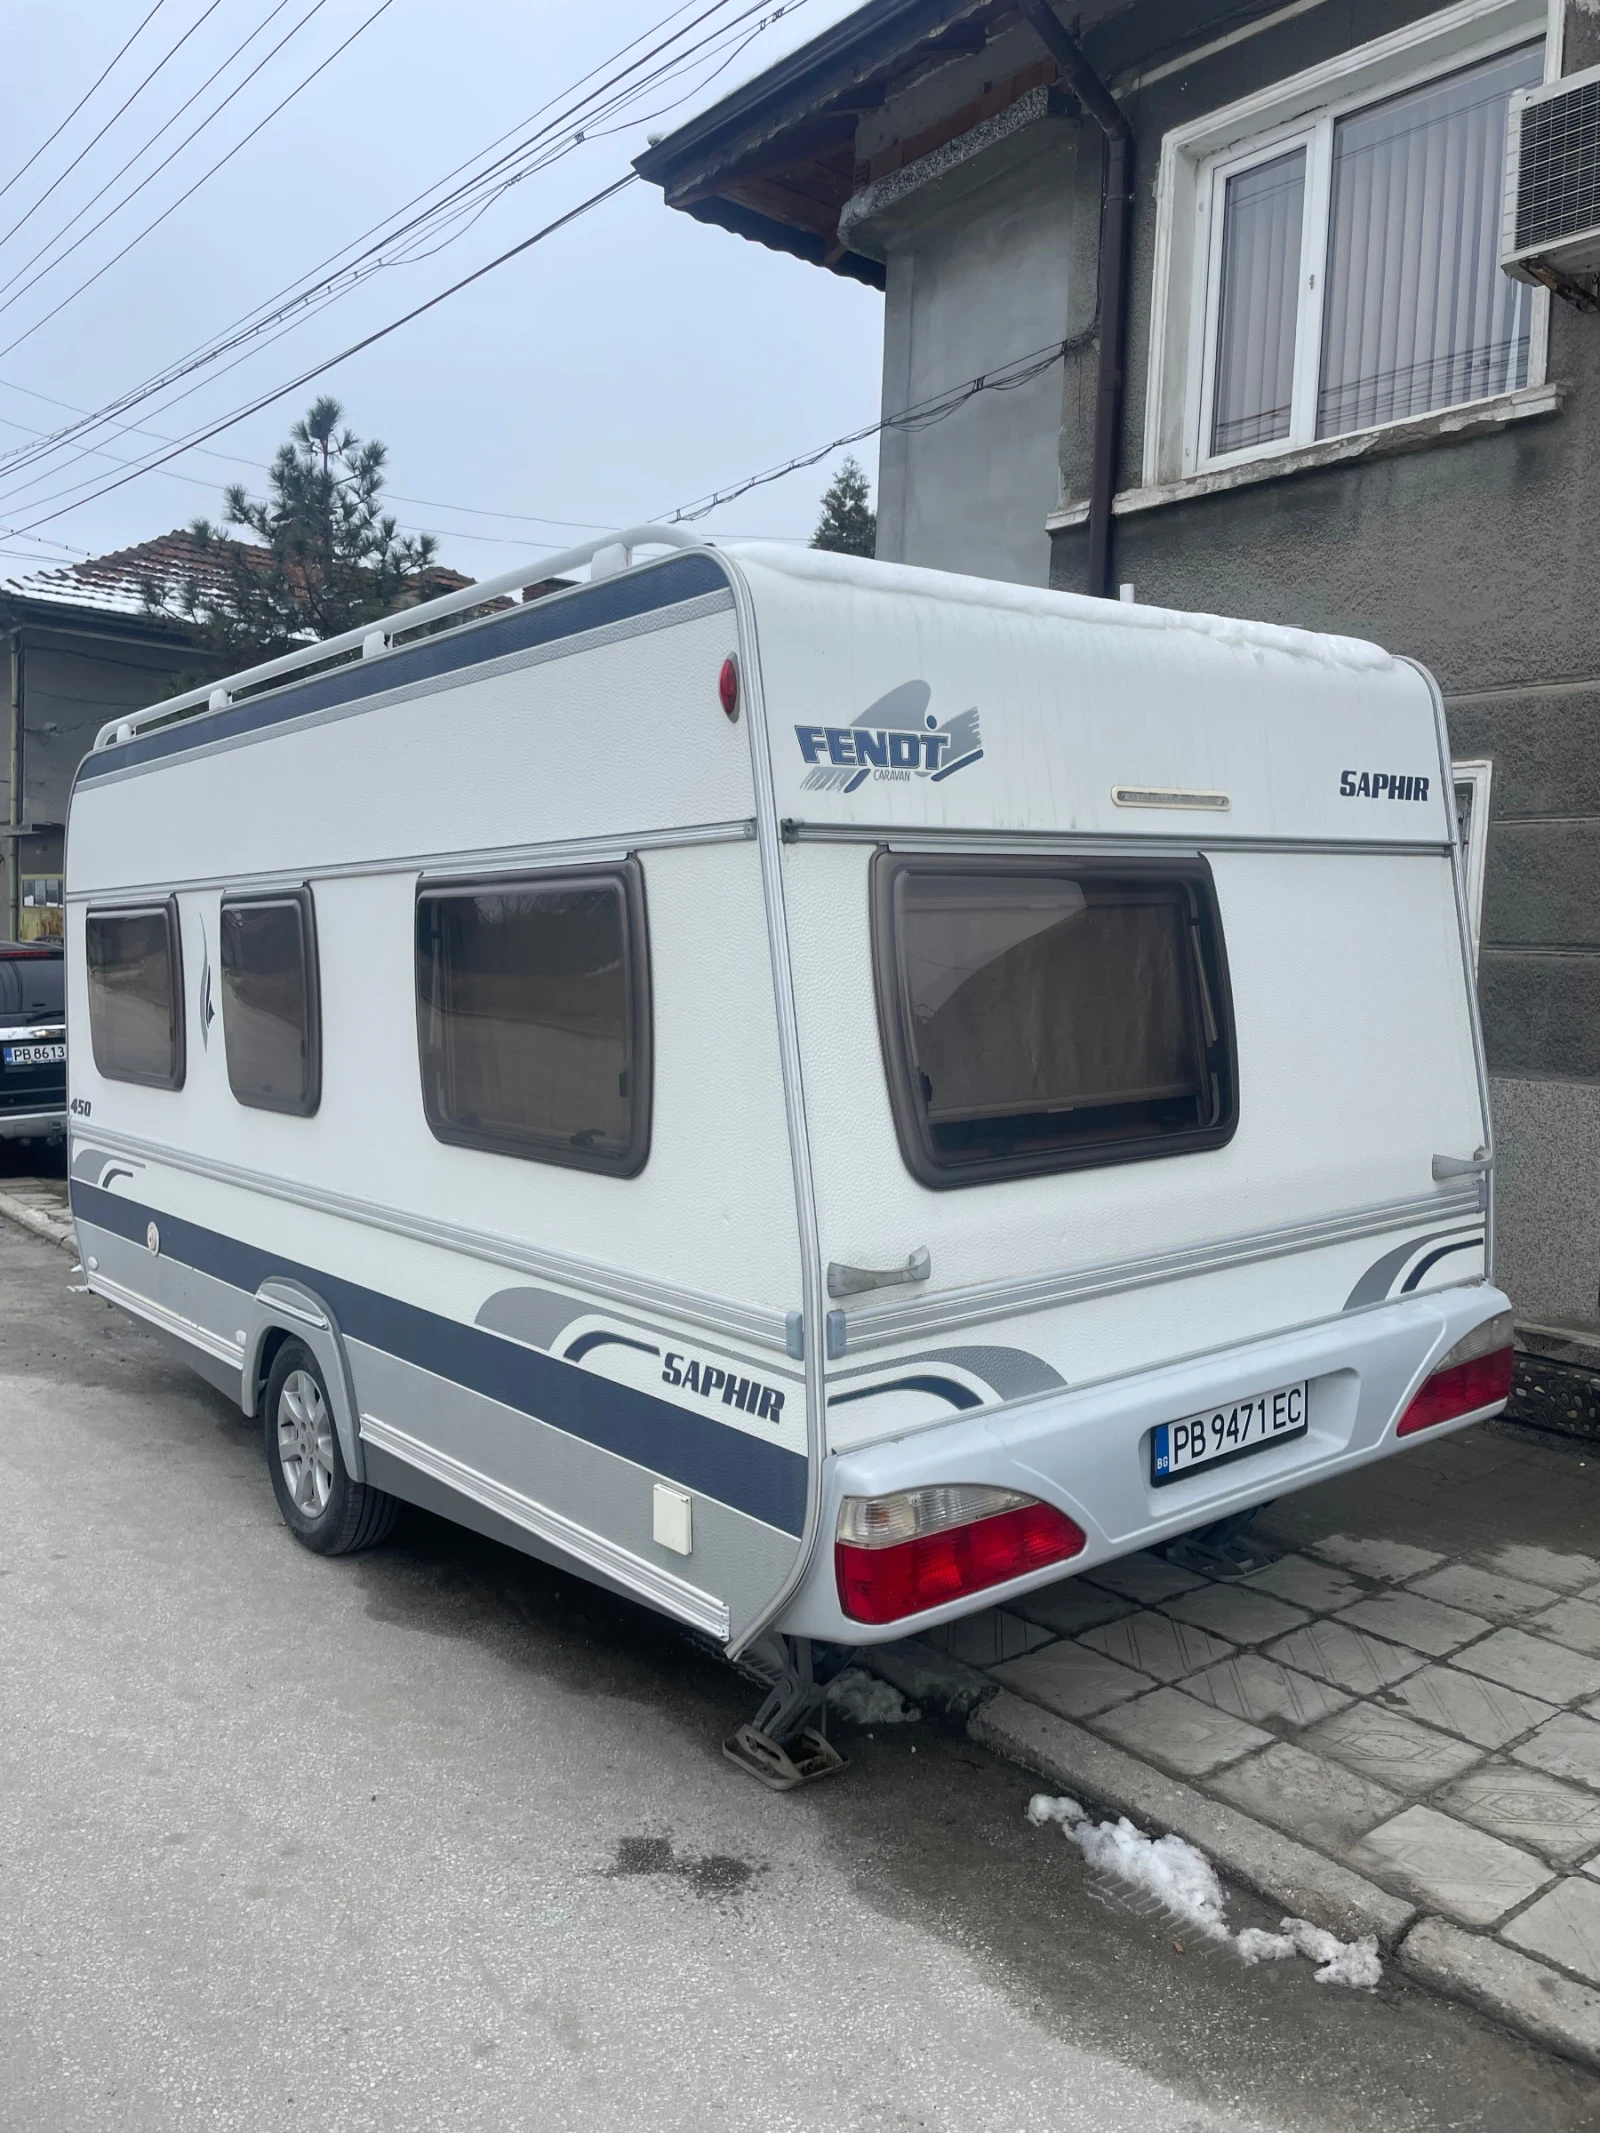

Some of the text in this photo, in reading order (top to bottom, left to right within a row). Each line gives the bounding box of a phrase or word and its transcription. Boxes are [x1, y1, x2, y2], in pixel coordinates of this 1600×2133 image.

[794, 725, 950, 770] FENDT
[873, 769, 911, 782] CARAVAN
[1339, 770, 1430, 802] SAPHIR
[70, 1098, 92, 1118] 450
[662, 1352, 786, 1425] SAPHIR
[1173, 1388, 1302, 1465] PB 9471 EC
[1156, 1455, 1169, 1470] BG
